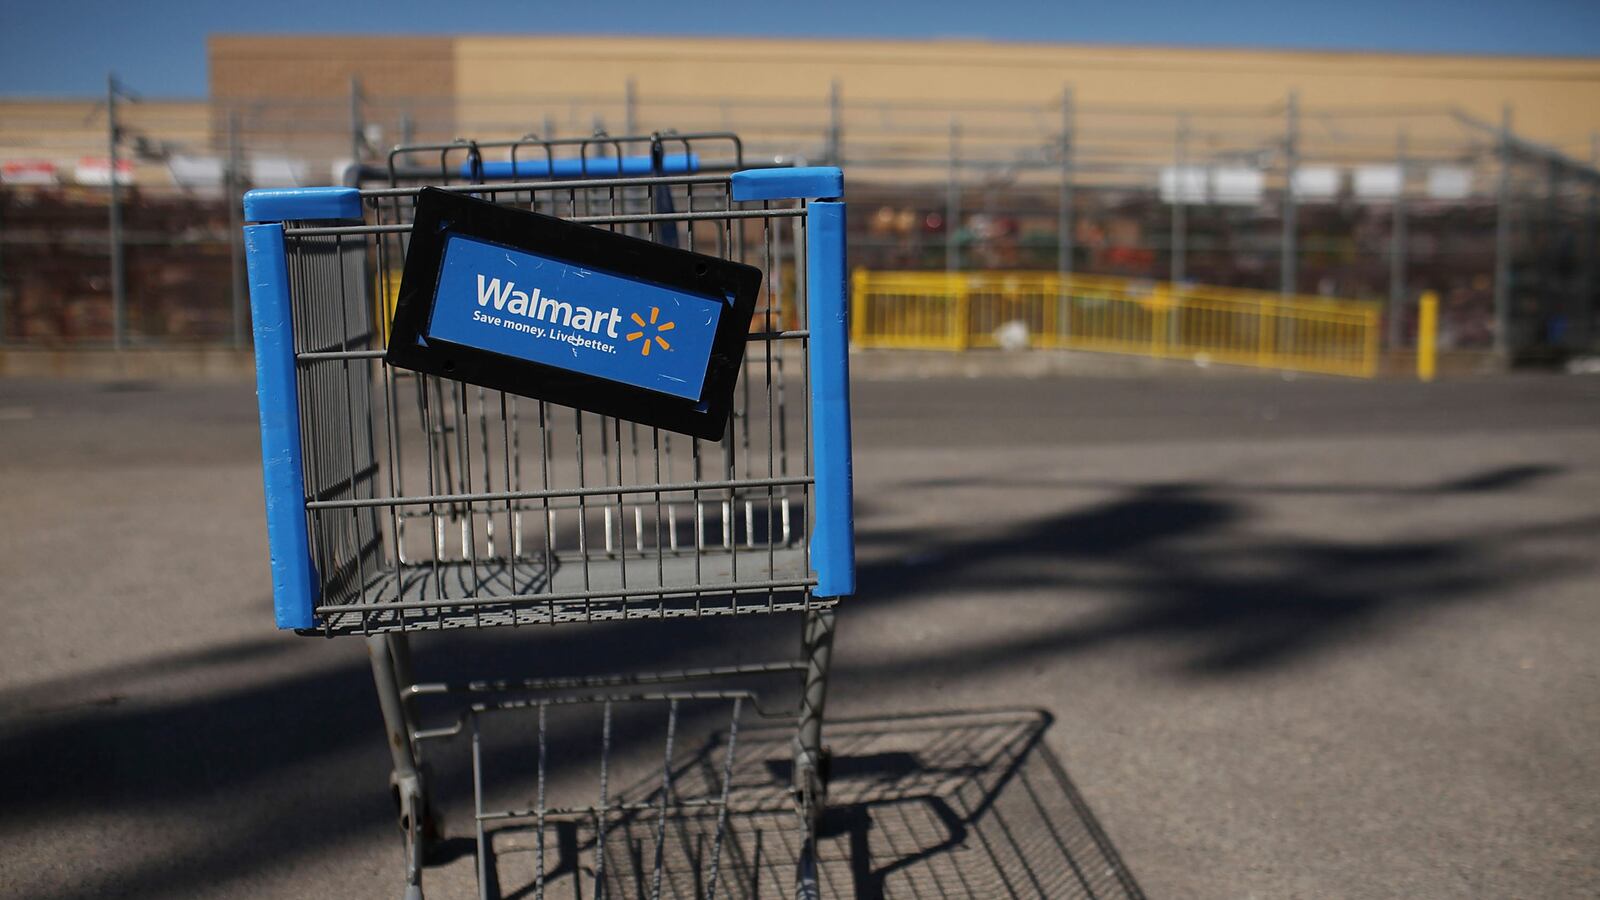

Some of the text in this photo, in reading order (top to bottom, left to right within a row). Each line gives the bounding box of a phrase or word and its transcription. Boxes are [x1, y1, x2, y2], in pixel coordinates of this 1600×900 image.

[473, 310, 617, 354] Save money. Live better.
[477, 274, 622, 338] Walmart
